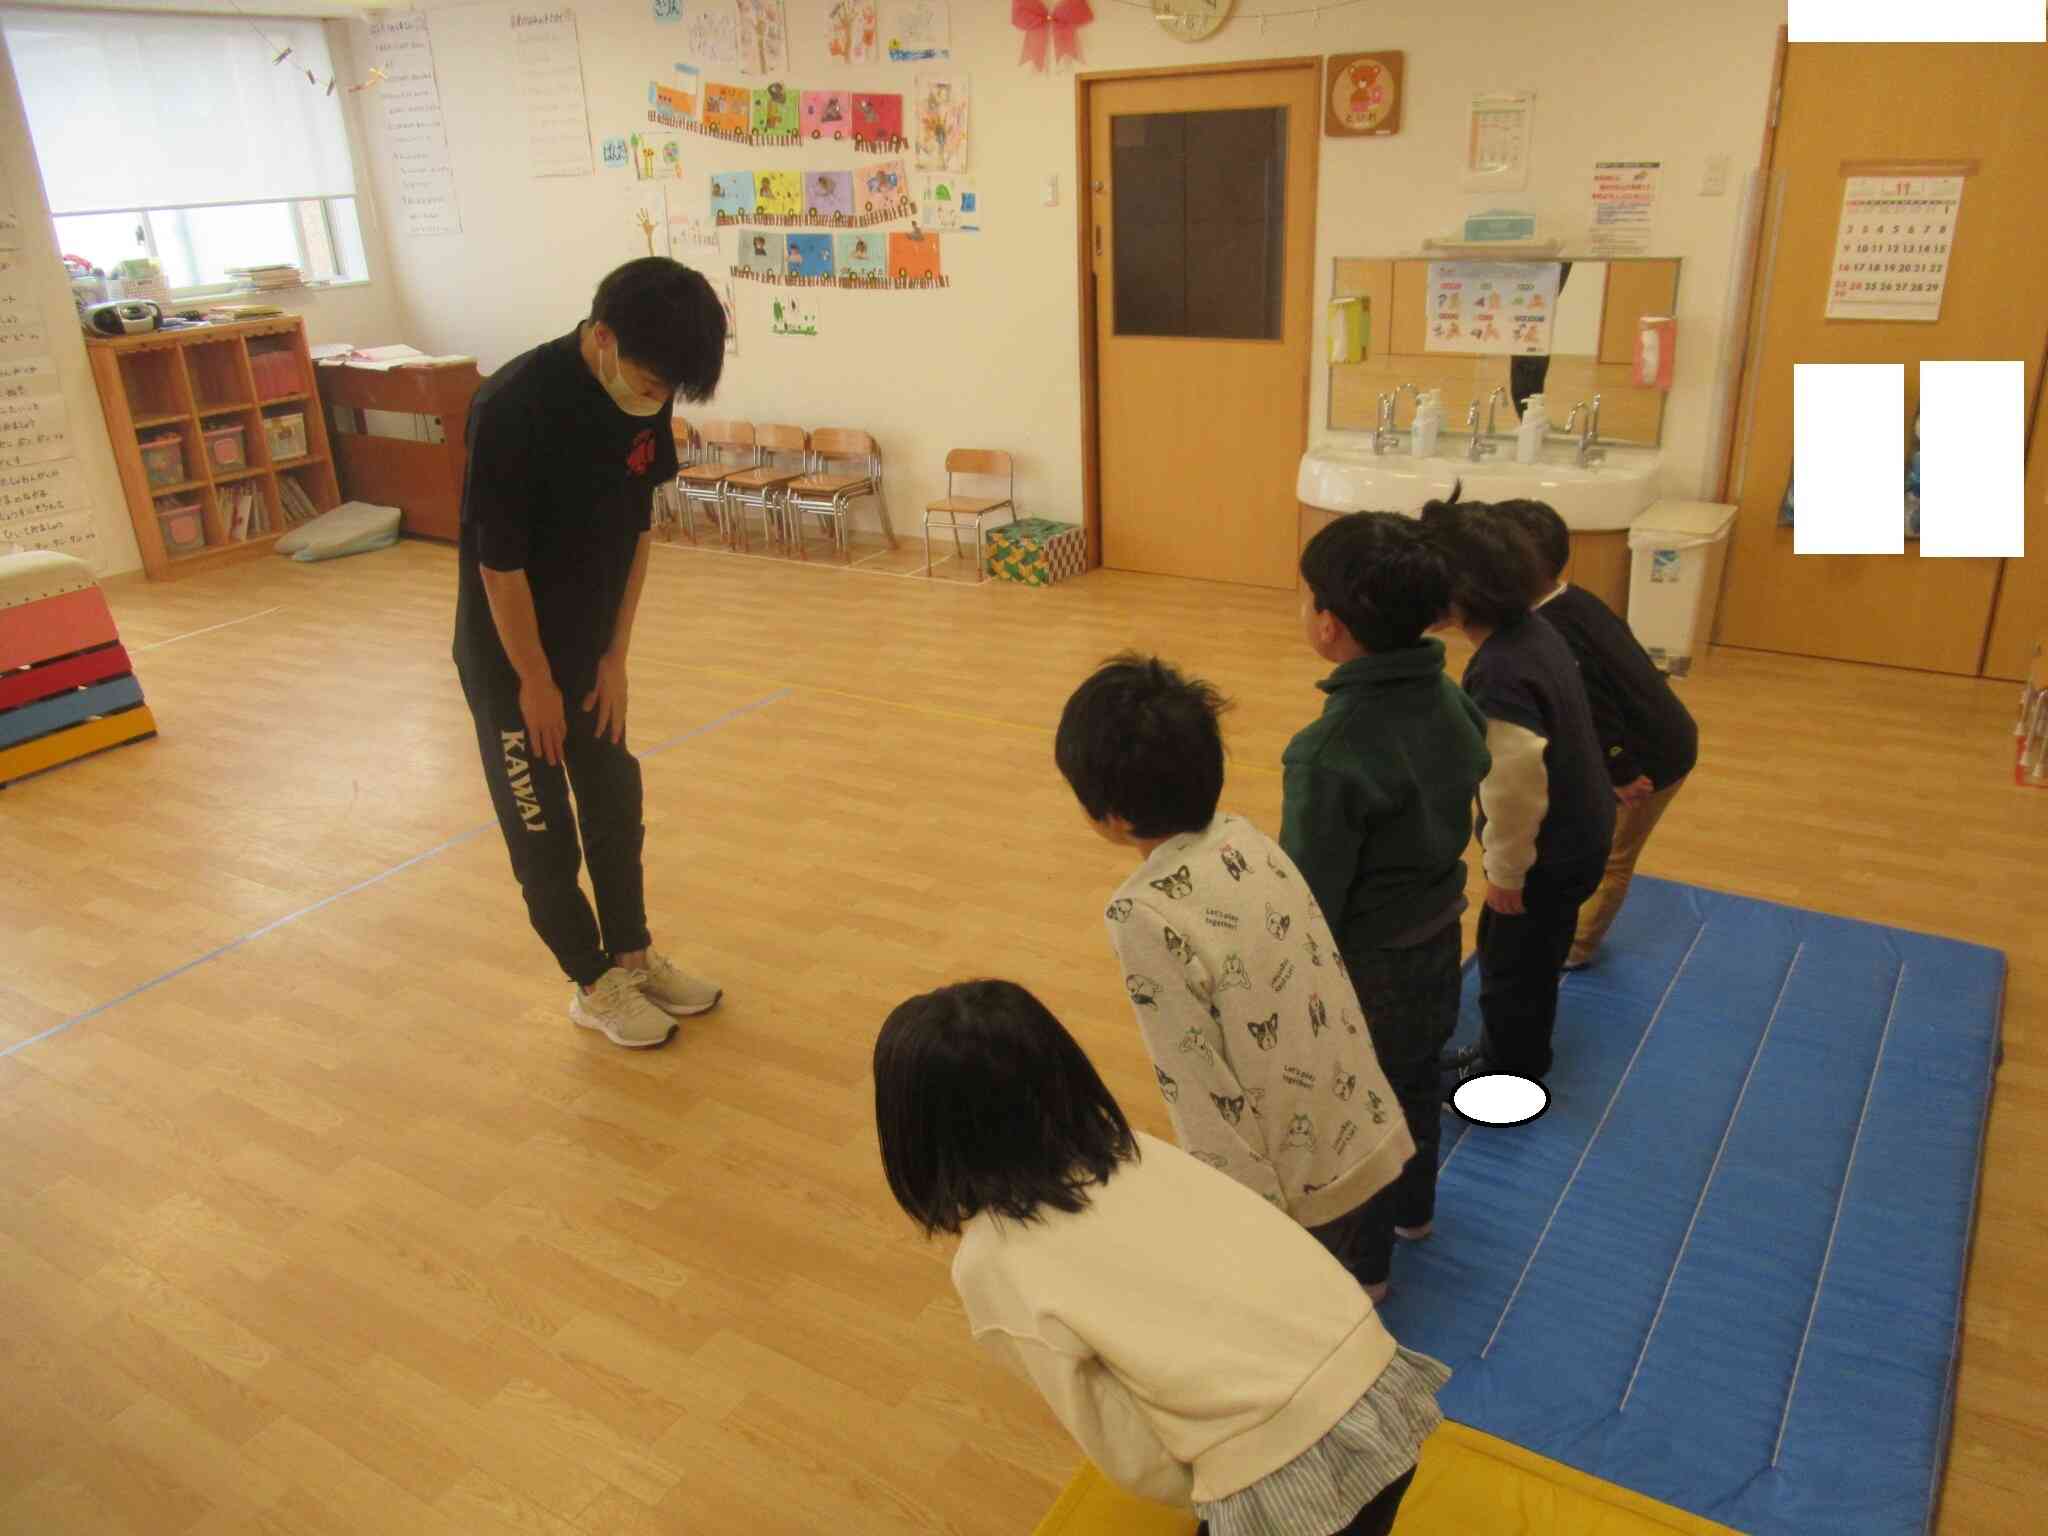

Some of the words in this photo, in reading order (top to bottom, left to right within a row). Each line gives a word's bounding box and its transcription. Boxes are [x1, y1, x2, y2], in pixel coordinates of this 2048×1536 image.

[1857, 244, 1868, 253] 10
[1871, 244, 1883, 253] 11
[1887, 244, 1900, 253] 12
[1903, 244, 1914, 253] 13
[1918, 244, 1931, 253] 14
[1934, 244, 1946, 253] 15
[1839, 263, 1850, 272] 16
[1854, 263, 1865, 272] 17
[1868, 263, 1880, 272] 18
[1883, 263, 1896, 272] 19
[1898, 263, 1911, 272] 20
[1914, 263, 1926, 272] 21
[1929, 263, 1943, 272] 22
[501, 730, 548, 831] KAWAI
